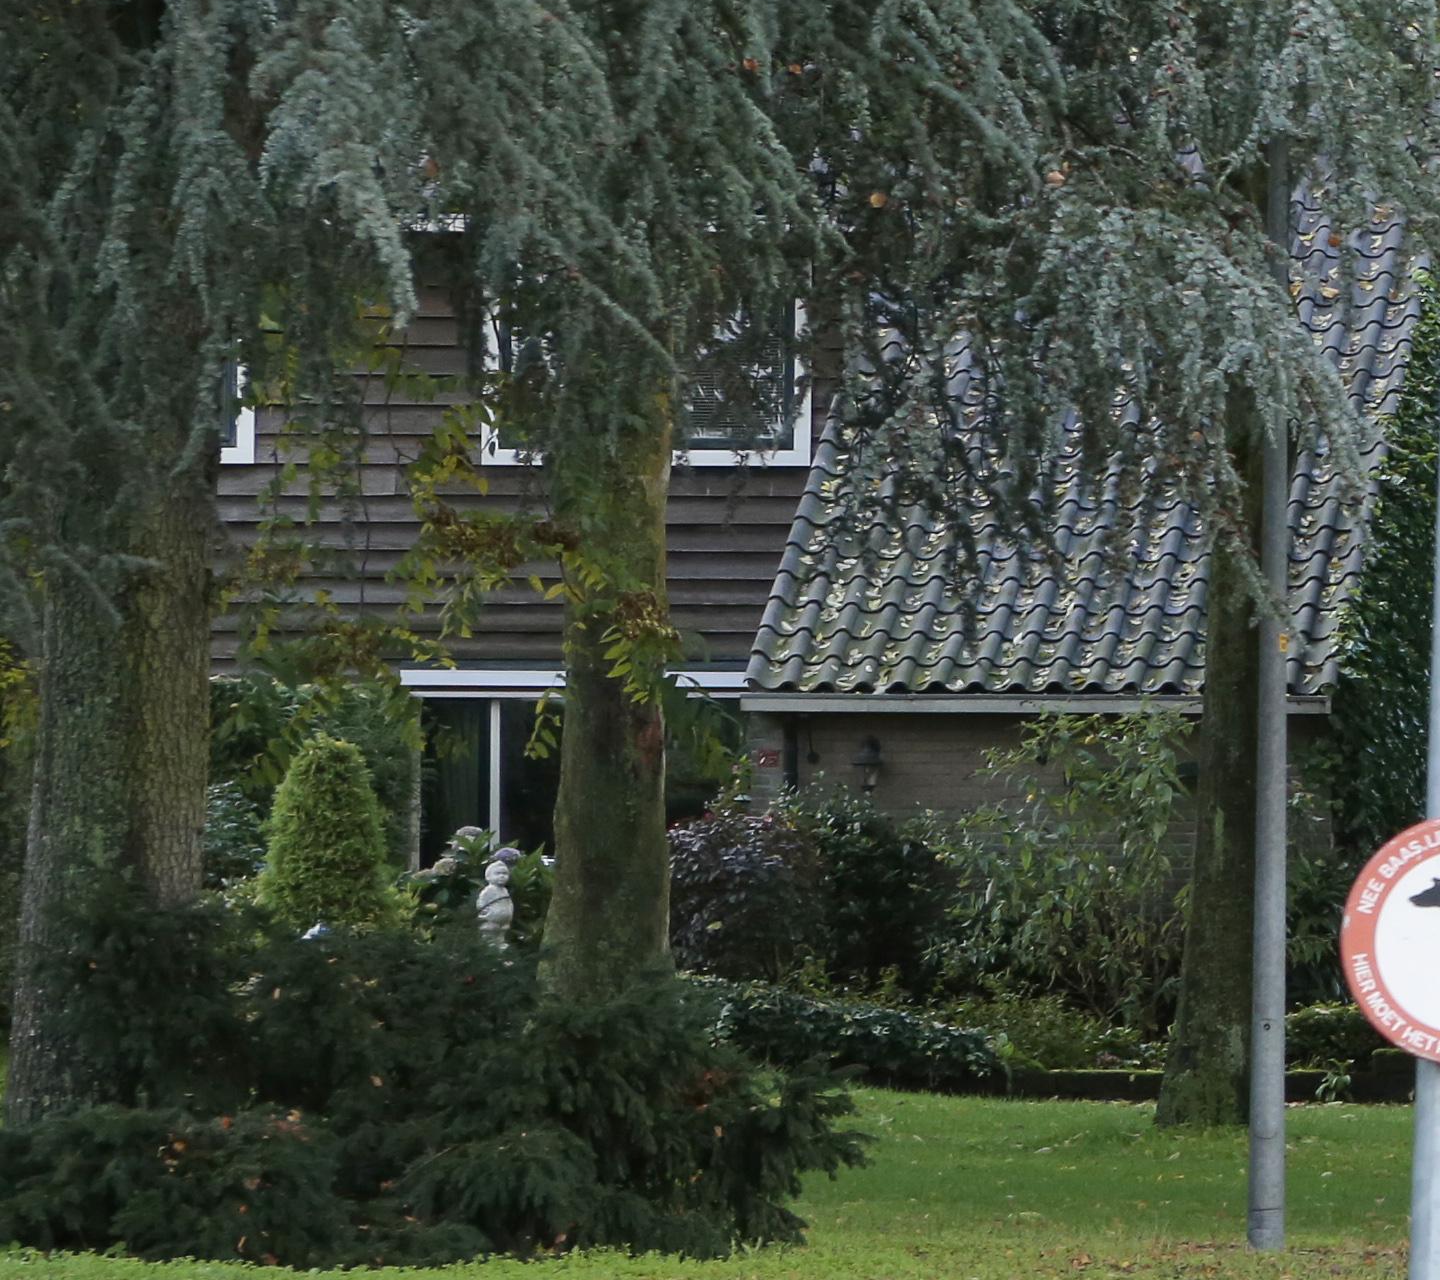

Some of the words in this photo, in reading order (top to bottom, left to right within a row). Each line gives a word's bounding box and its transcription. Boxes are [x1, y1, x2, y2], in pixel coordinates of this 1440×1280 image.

[1356, 878, 1386, 914] NEE
[1352, 953, 1377, 993] HIER
[1366, 991, 1407, 1032] MOET
[1401, 1026, 1438, 1052] HET
